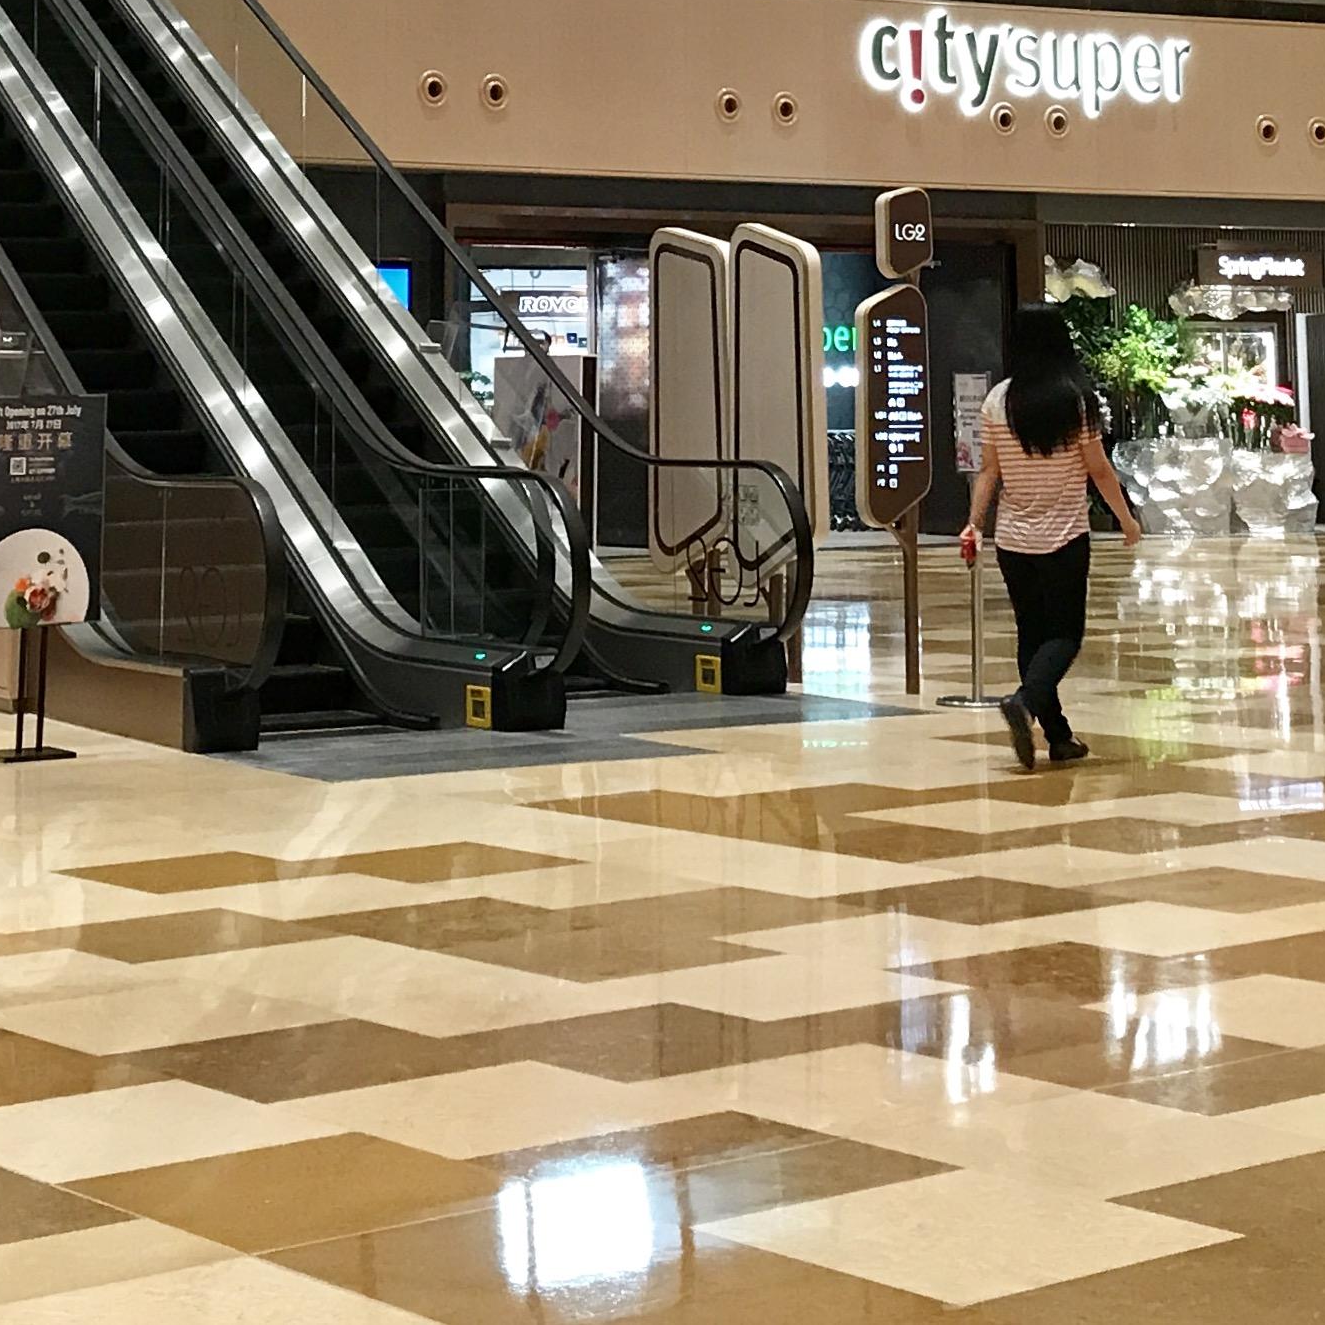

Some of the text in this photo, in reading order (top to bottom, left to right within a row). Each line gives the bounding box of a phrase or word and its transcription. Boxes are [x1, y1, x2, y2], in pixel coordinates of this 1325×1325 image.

[895, 223, 926, 241] LG2
[4, 406, 35, 418] Opening
[47, 405, 64, 415] 27th
[65, 405, 82, 417] July
